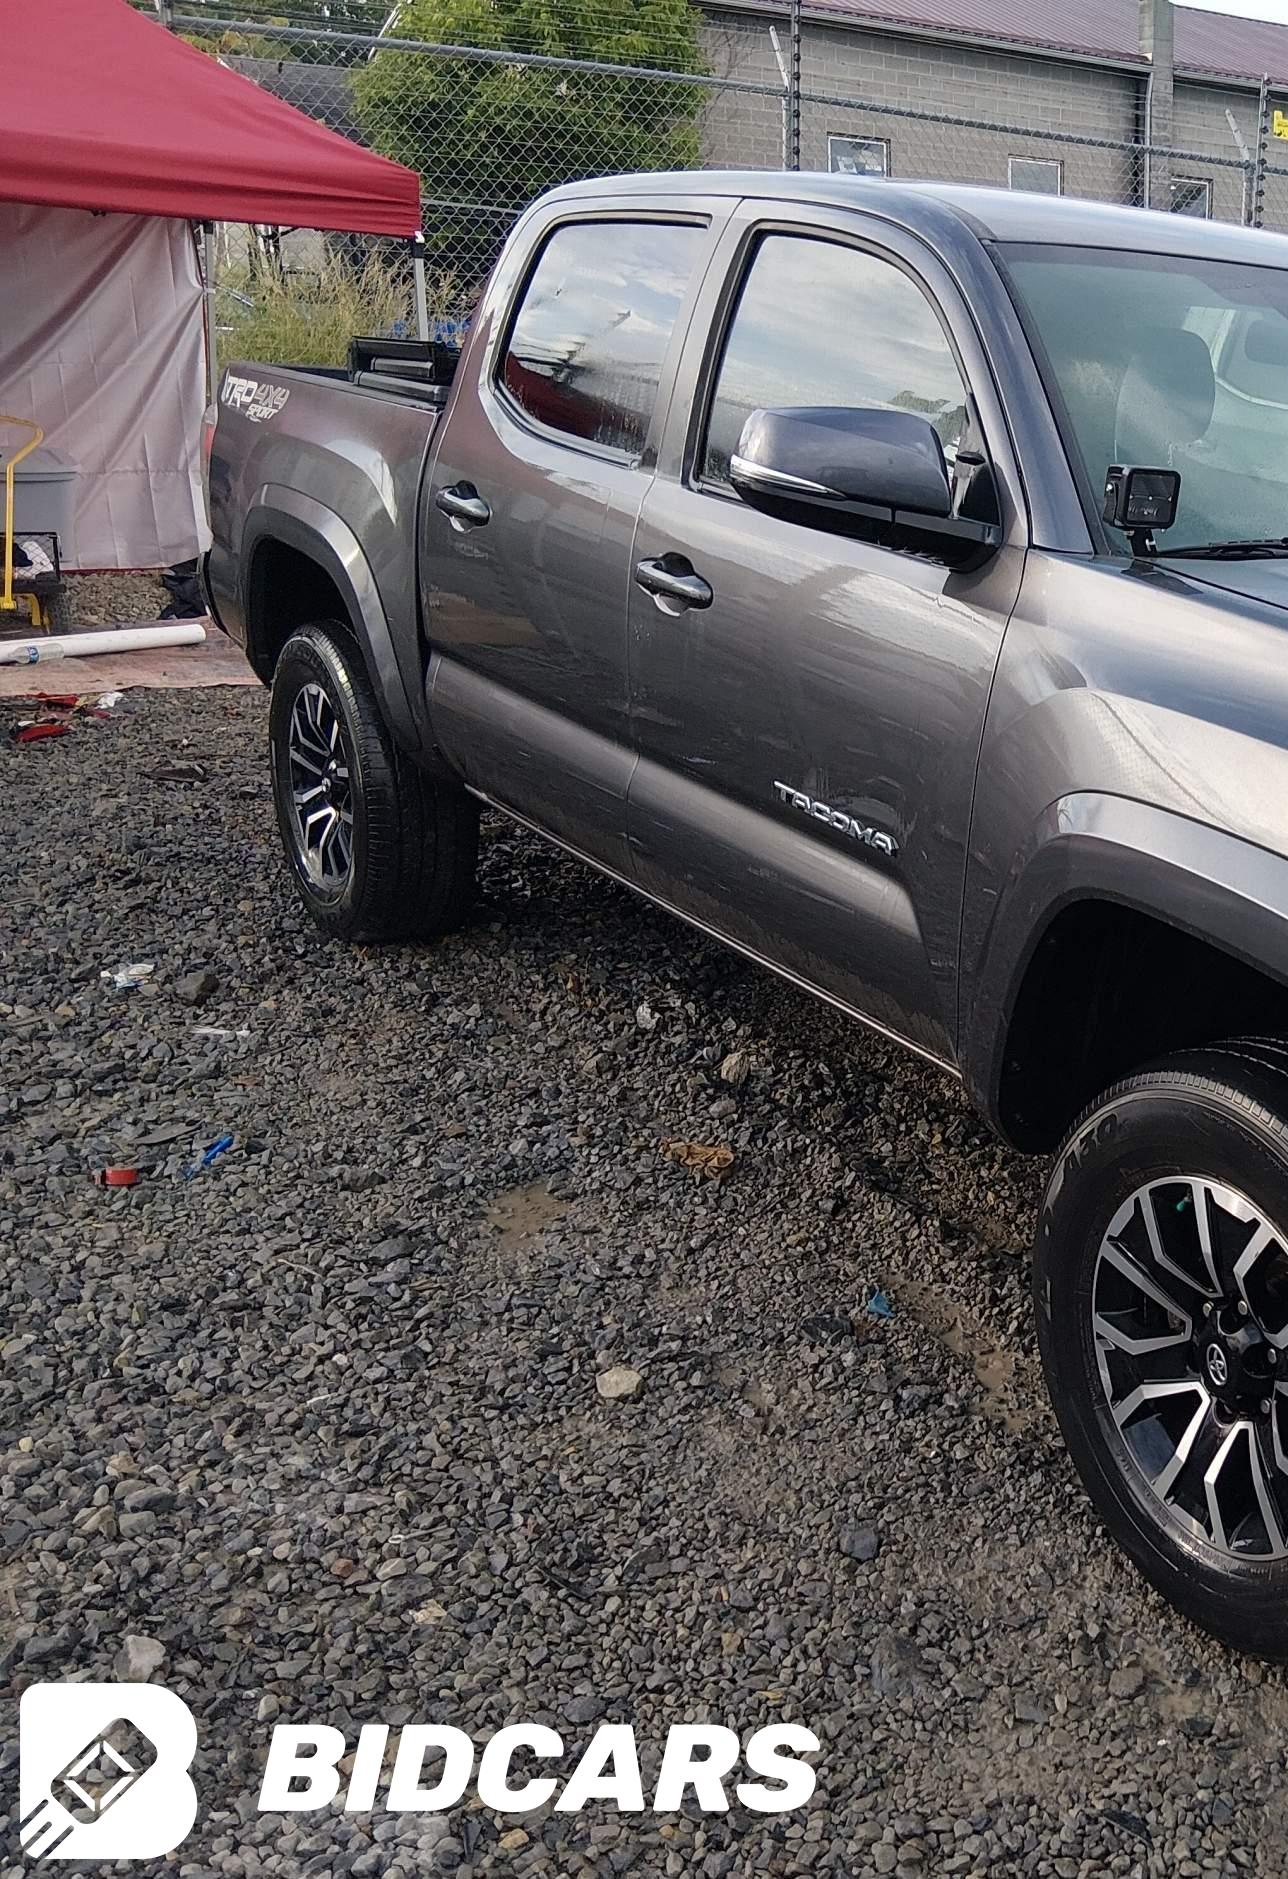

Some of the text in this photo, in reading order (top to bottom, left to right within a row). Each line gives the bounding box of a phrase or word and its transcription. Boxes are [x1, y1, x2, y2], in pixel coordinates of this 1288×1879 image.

[226, 375, 258, 408] TRD
[246, 403, 279, 420] SPORT
[773, 780, 900, 856] TACOMA
